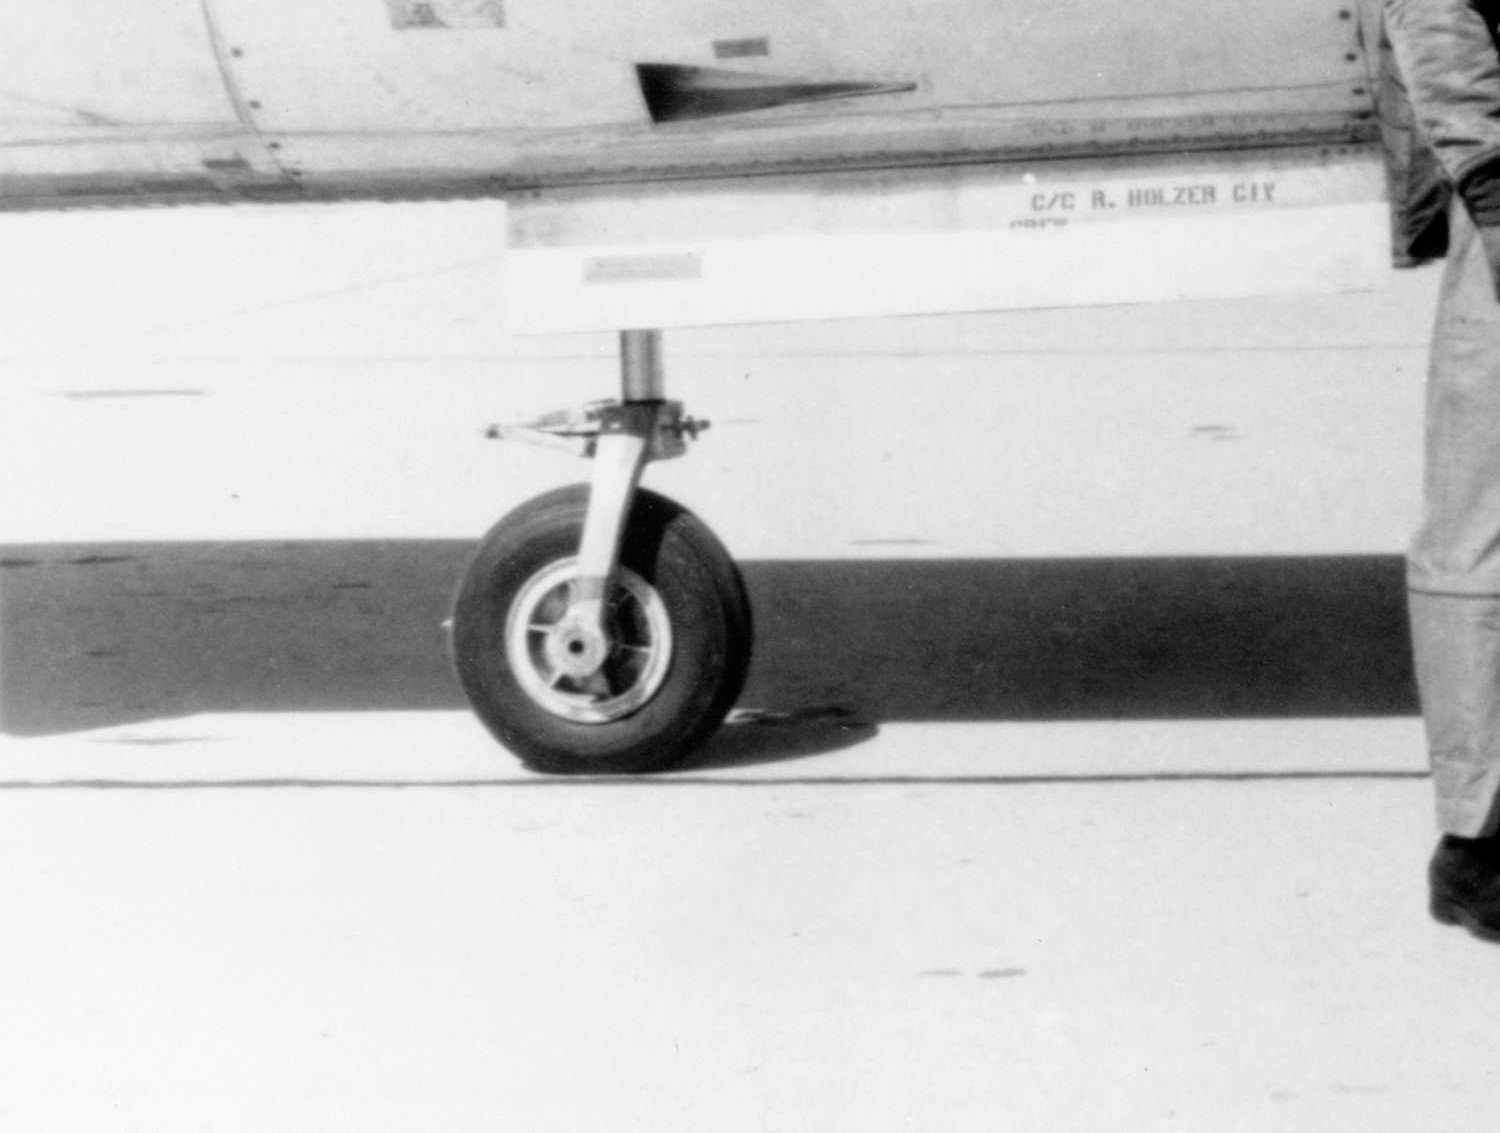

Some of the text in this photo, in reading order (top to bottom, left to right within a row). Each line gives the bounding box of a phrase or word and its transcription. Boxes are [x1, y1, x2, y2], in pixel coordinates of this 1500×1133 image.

[1031, 192, 1076, 213] C/C
[1092, 188, 1117, 209] R.
[1128, 185, 1217, 208] HOLZER
